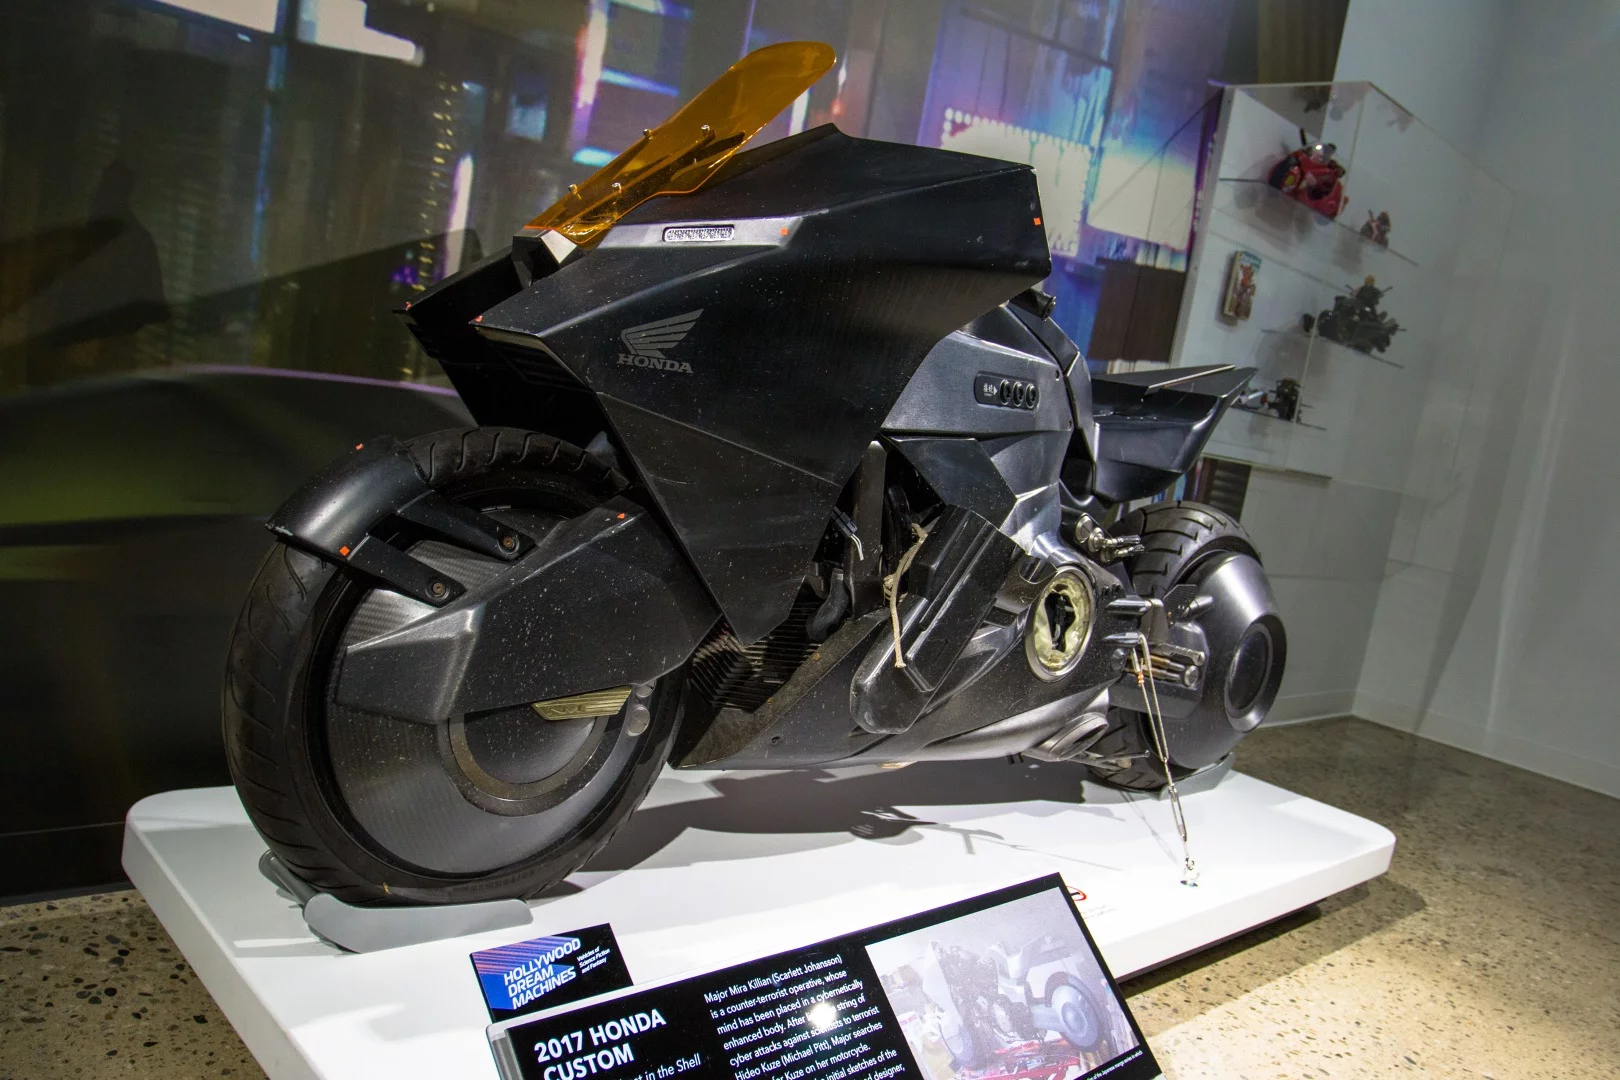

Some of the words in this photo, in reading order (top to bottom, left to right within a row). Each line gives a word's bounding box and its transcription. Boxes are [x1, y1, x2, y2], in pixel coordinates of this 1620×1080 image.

[617, 353, 693, 373] HONDA
[503, 937, 581, 986] HOLLYWOOD
[581, 964, 591, 974] and
[595, 949, 610, 960] Fiction
[507, 964, 554, 997] DREAM
[512, 966, 577, 1010] MACHINES
[704, 990, 729, 1003] Major
[728, 986, 748, 997] Mira
[747, 977, 772, 990] Killian
[771, 967, 804, 985] (Scarlett
[804, 954, 842, 974] Johansson)
[710, 1009, 718, 1019] is
[726, 988, 788, 1014] counter-terrorist
[788, 978, 825, 995] operative,
[824, 969, 847, 983] whose
[717, 1019, 738, 1035] mind
[738, 1017, 754, 1028] has
[753, 1010, 775, 1022] been
[775, 1000, 801, 1017] placed
[801, 997, 810, 1007] in
[816, 979, 863, 1002] cybernetically
[723, 1028, 763, 1050] enhanced
[762, 1022, 787, 1037] body.
[786, 1016, 806, 1028] After
[836, 998, 858, 1011] string
[858, 993, 866, 1003] of
[534, 1031, 583, 1063] 2017
[588, 1008, 667, 1046] HONDA
[729, 1051, 753, 1068] cyber
[753, 1040, 783, 1058] attacks
[783, 1030, 811, 1048] against
[843, 1016, 852, 1025] to
[851, 1005, 880, 1022] terrorist
[735, 1065, 761, 1080] Hideo
[760, 1059, 781, 1073] Kuze
[780, 1045, 814, 1066] (Michael
[813, 1039, 832, 1053] Pitt),
[830, 1032, 852, 1046] Major
[852, 1021, 883, 1038] searches
[543, 1043, 635, 1080] CUSTOM
[645, 1071, 656, 1080] in
[657, 1065, 675, 1079] the
[676, 1052, 701, 1073] Shell
[784, 1069, 805, 1080] Kuze
[805, 1064, 816, 1074] on
[815, 1059, 829, 1070] her
[829, 1043, 871, 1064] motorcycle.
[825, 1066, 847, 1080] initial
[846, 1058, 878, 1075] sketches
[877, 1051, 885, 1062] of
[884, 1048, 897, 1059] the
[873, 1063, 906, 1080] designer,
